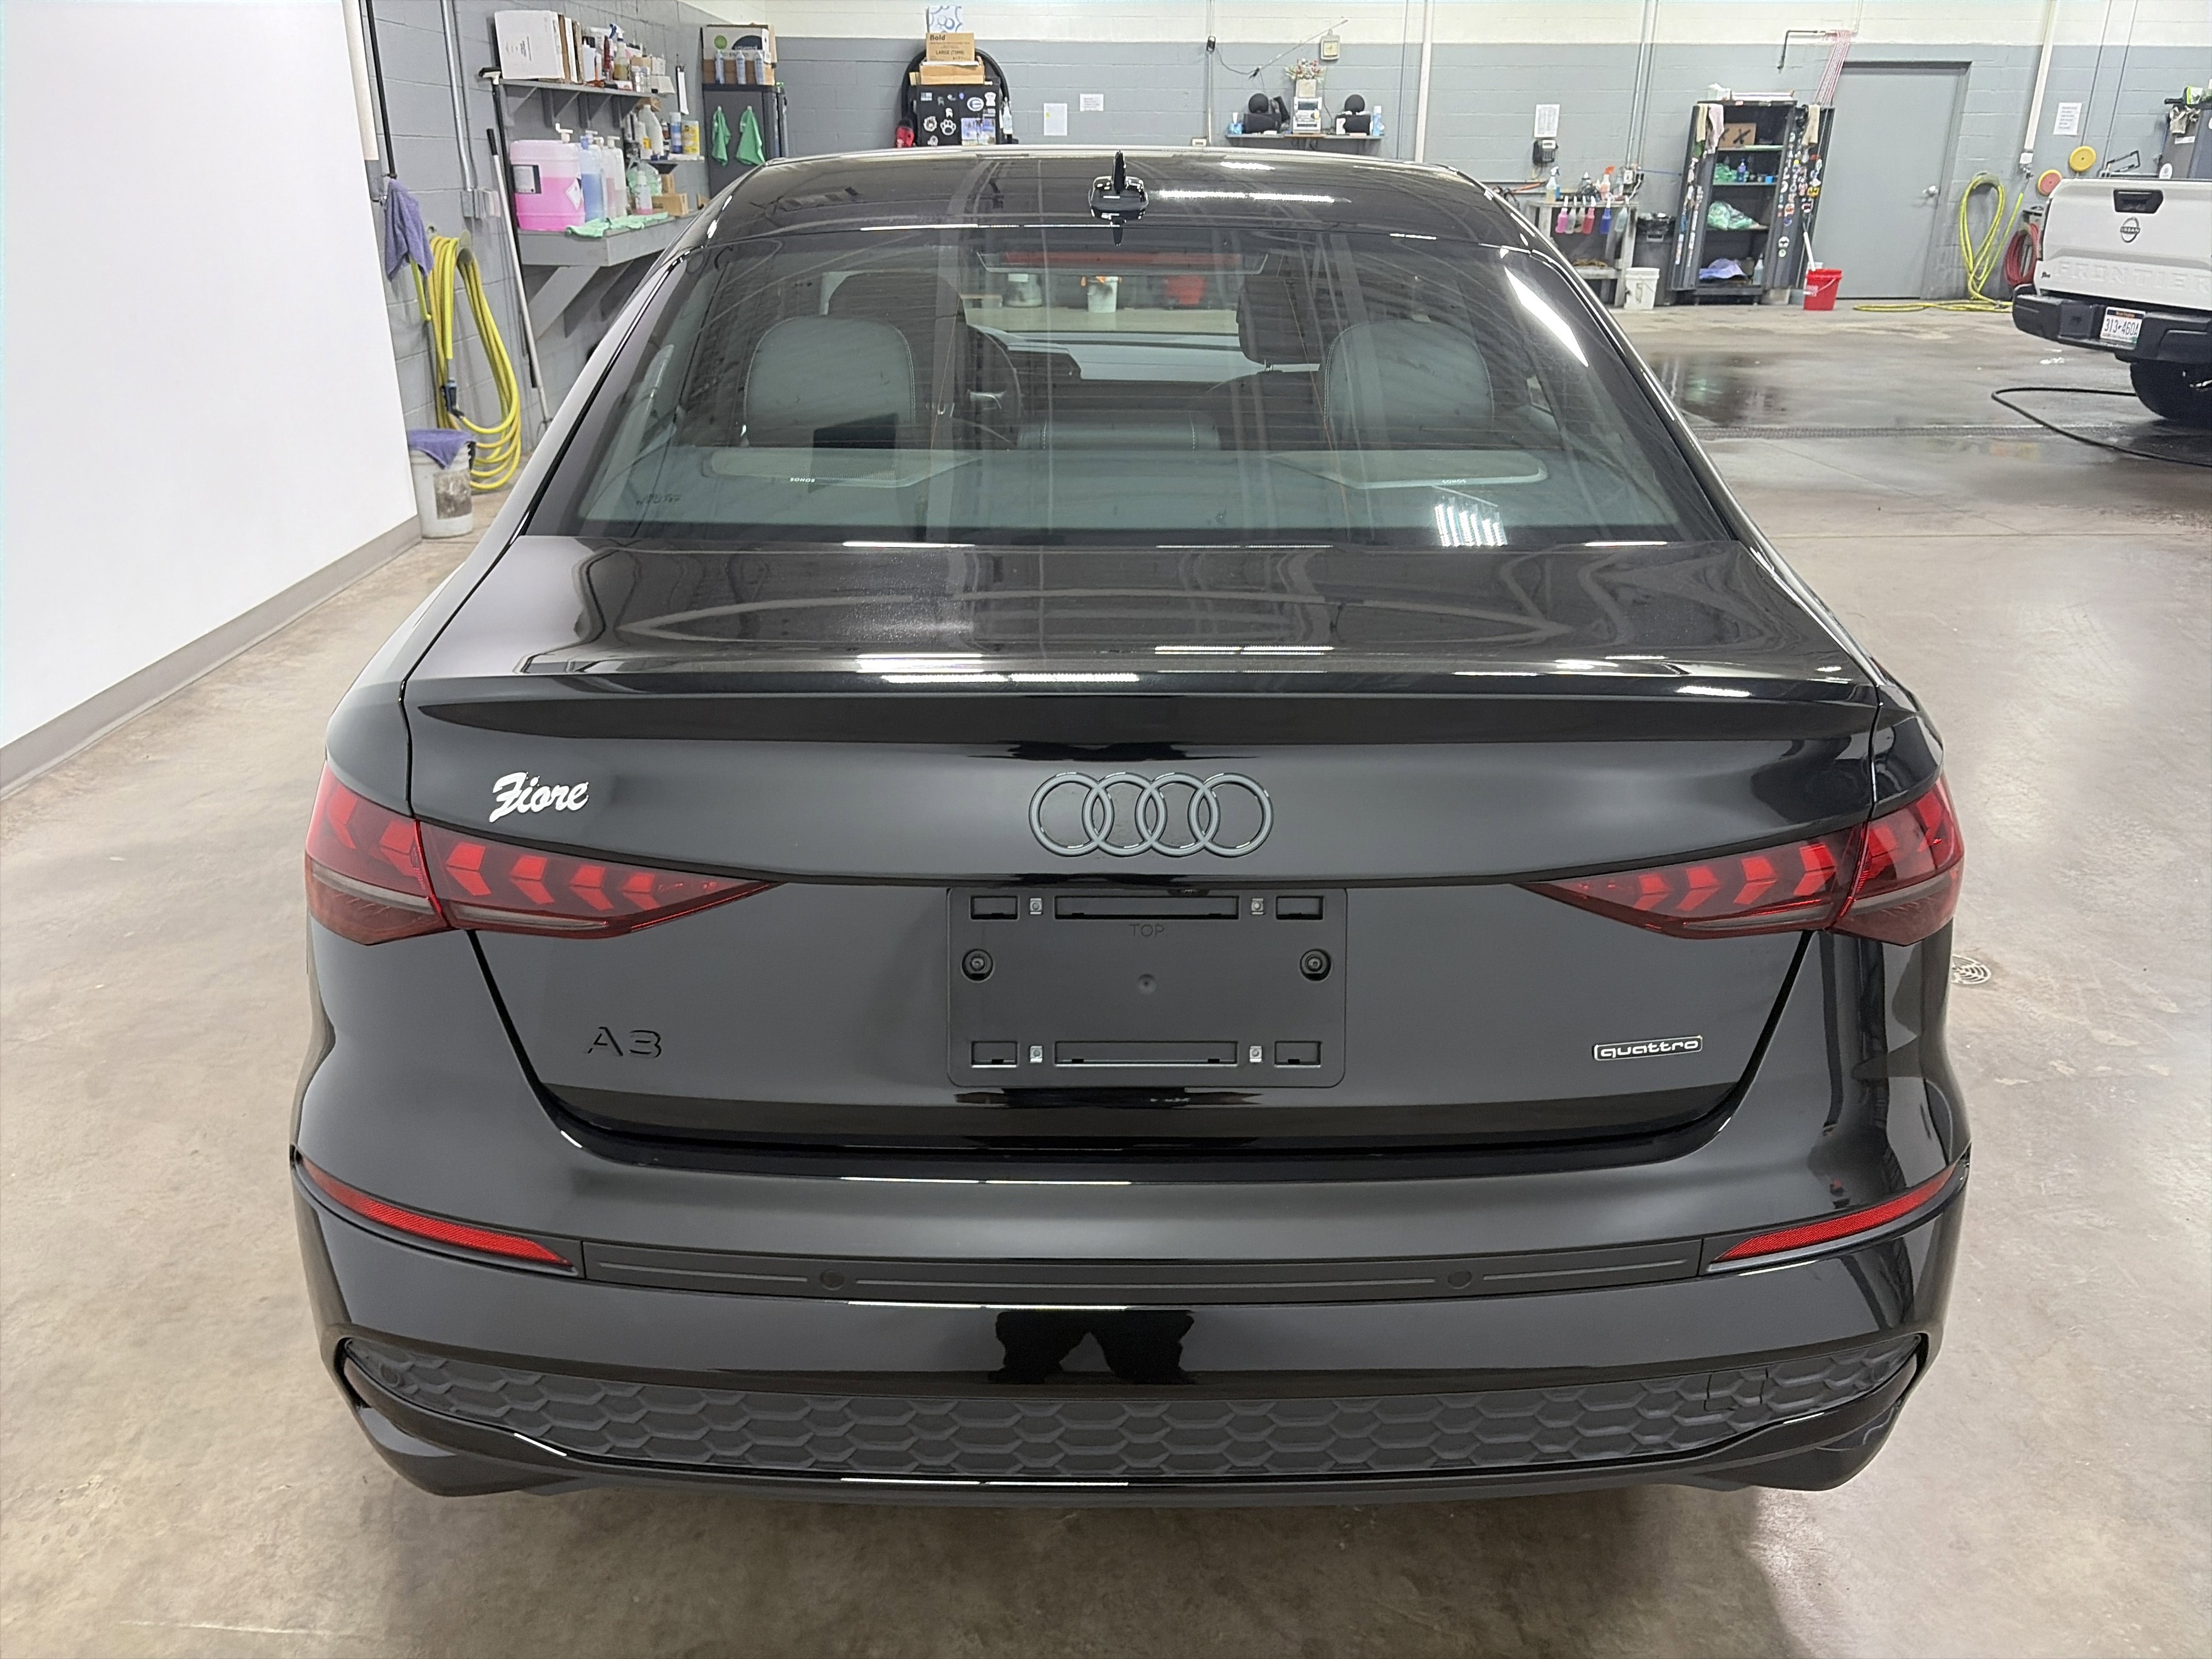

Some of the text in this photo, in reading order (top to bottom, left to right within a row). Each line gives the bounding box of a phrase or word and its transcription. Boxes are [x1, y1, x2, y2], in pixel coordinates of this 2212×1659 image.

[489, 772, 589, 823] Fiore
[1130, 924, 1164, 937] TOP
[584, 1026, 662, 1058] A3
[1601, 1040, 1699, 1058] quattro
